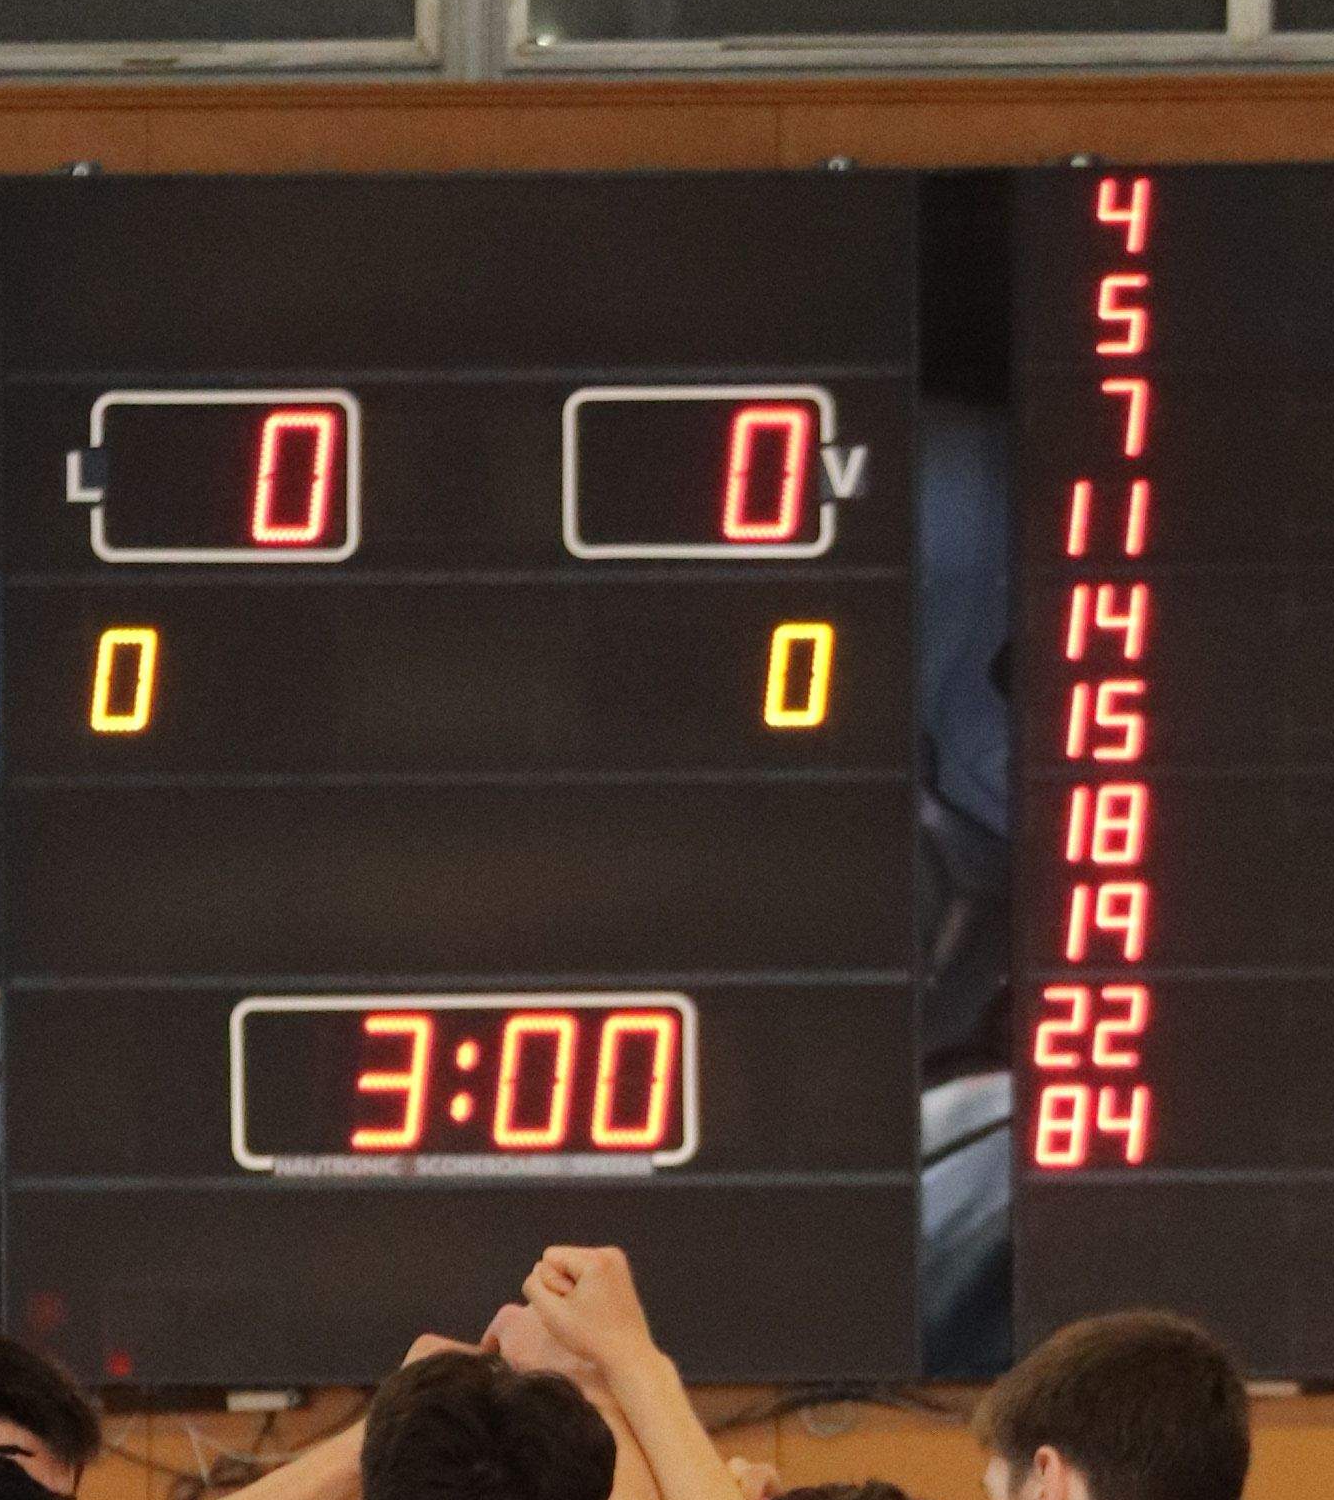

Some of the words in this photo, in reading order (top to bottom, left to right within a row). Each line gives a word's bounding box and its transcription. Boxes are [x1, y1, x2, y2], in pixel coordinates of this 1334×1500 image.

[1096, 178, 1151, 254] 4
[1096, 274, 1149, 356] 5
[1102, 377, 1151, 458] 7
[66, 451, 105, 503] L
[250, 408, 338, 546] 0
[722, 405, 810, 543] 0
[820, 444, 867, 499] V
[1066, 478, 1151, 558] 11
[1064, 582, 1151, 662] 14
[90, 627, 159, 734] 0
[764, 622, 836, 729] 0
[1065, 678, 1148, 764] 15
[1064, 782, 1149, 866] 18
[1065, 880, 1149, 963] 19
[1033, 983, 1150, 1069] 22
[350, 1006, 681, 1156] 3:00
[1031, 1083, 1151, 1169] 84
